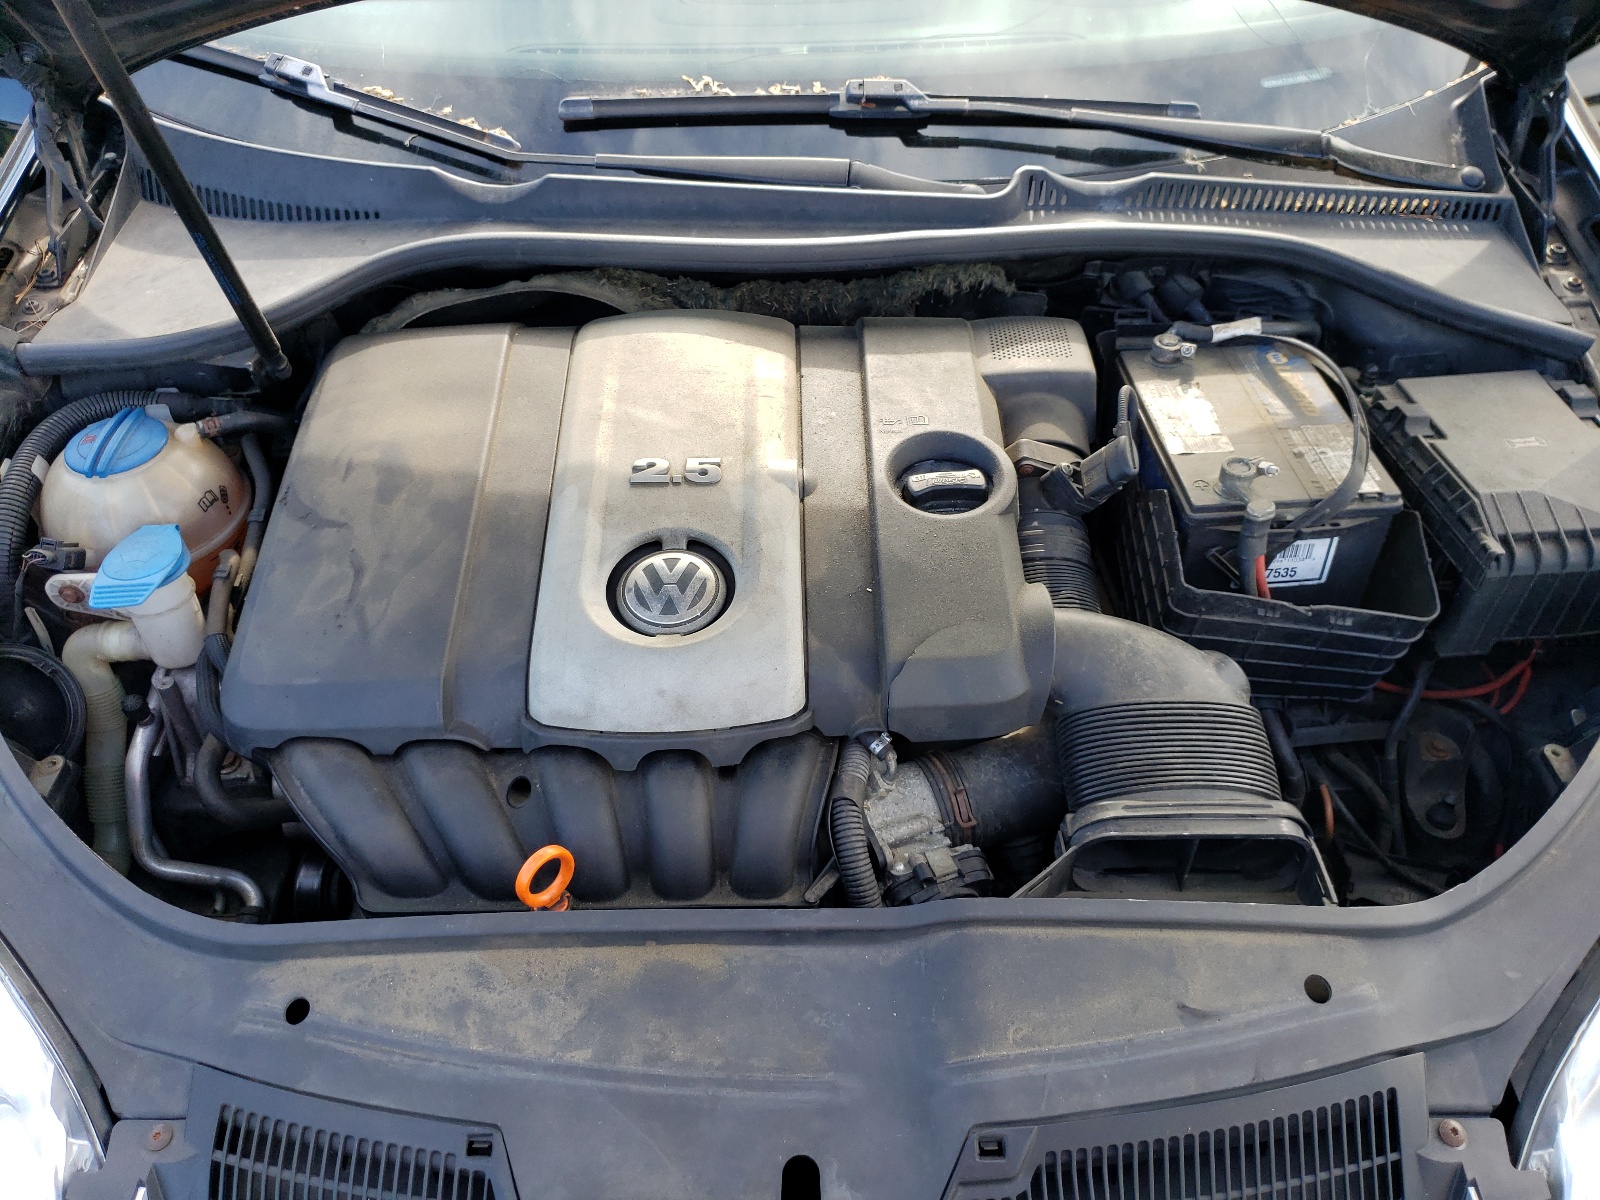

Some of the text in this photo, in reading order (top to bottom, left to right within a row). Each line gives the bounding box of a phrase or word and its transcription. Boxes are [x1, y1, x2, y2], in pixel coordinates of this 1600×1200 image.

[630, 457, 722, 486] 2.5
[1266, 566, 1298, 579] 7535
[624, 555, 718, 626] VW
